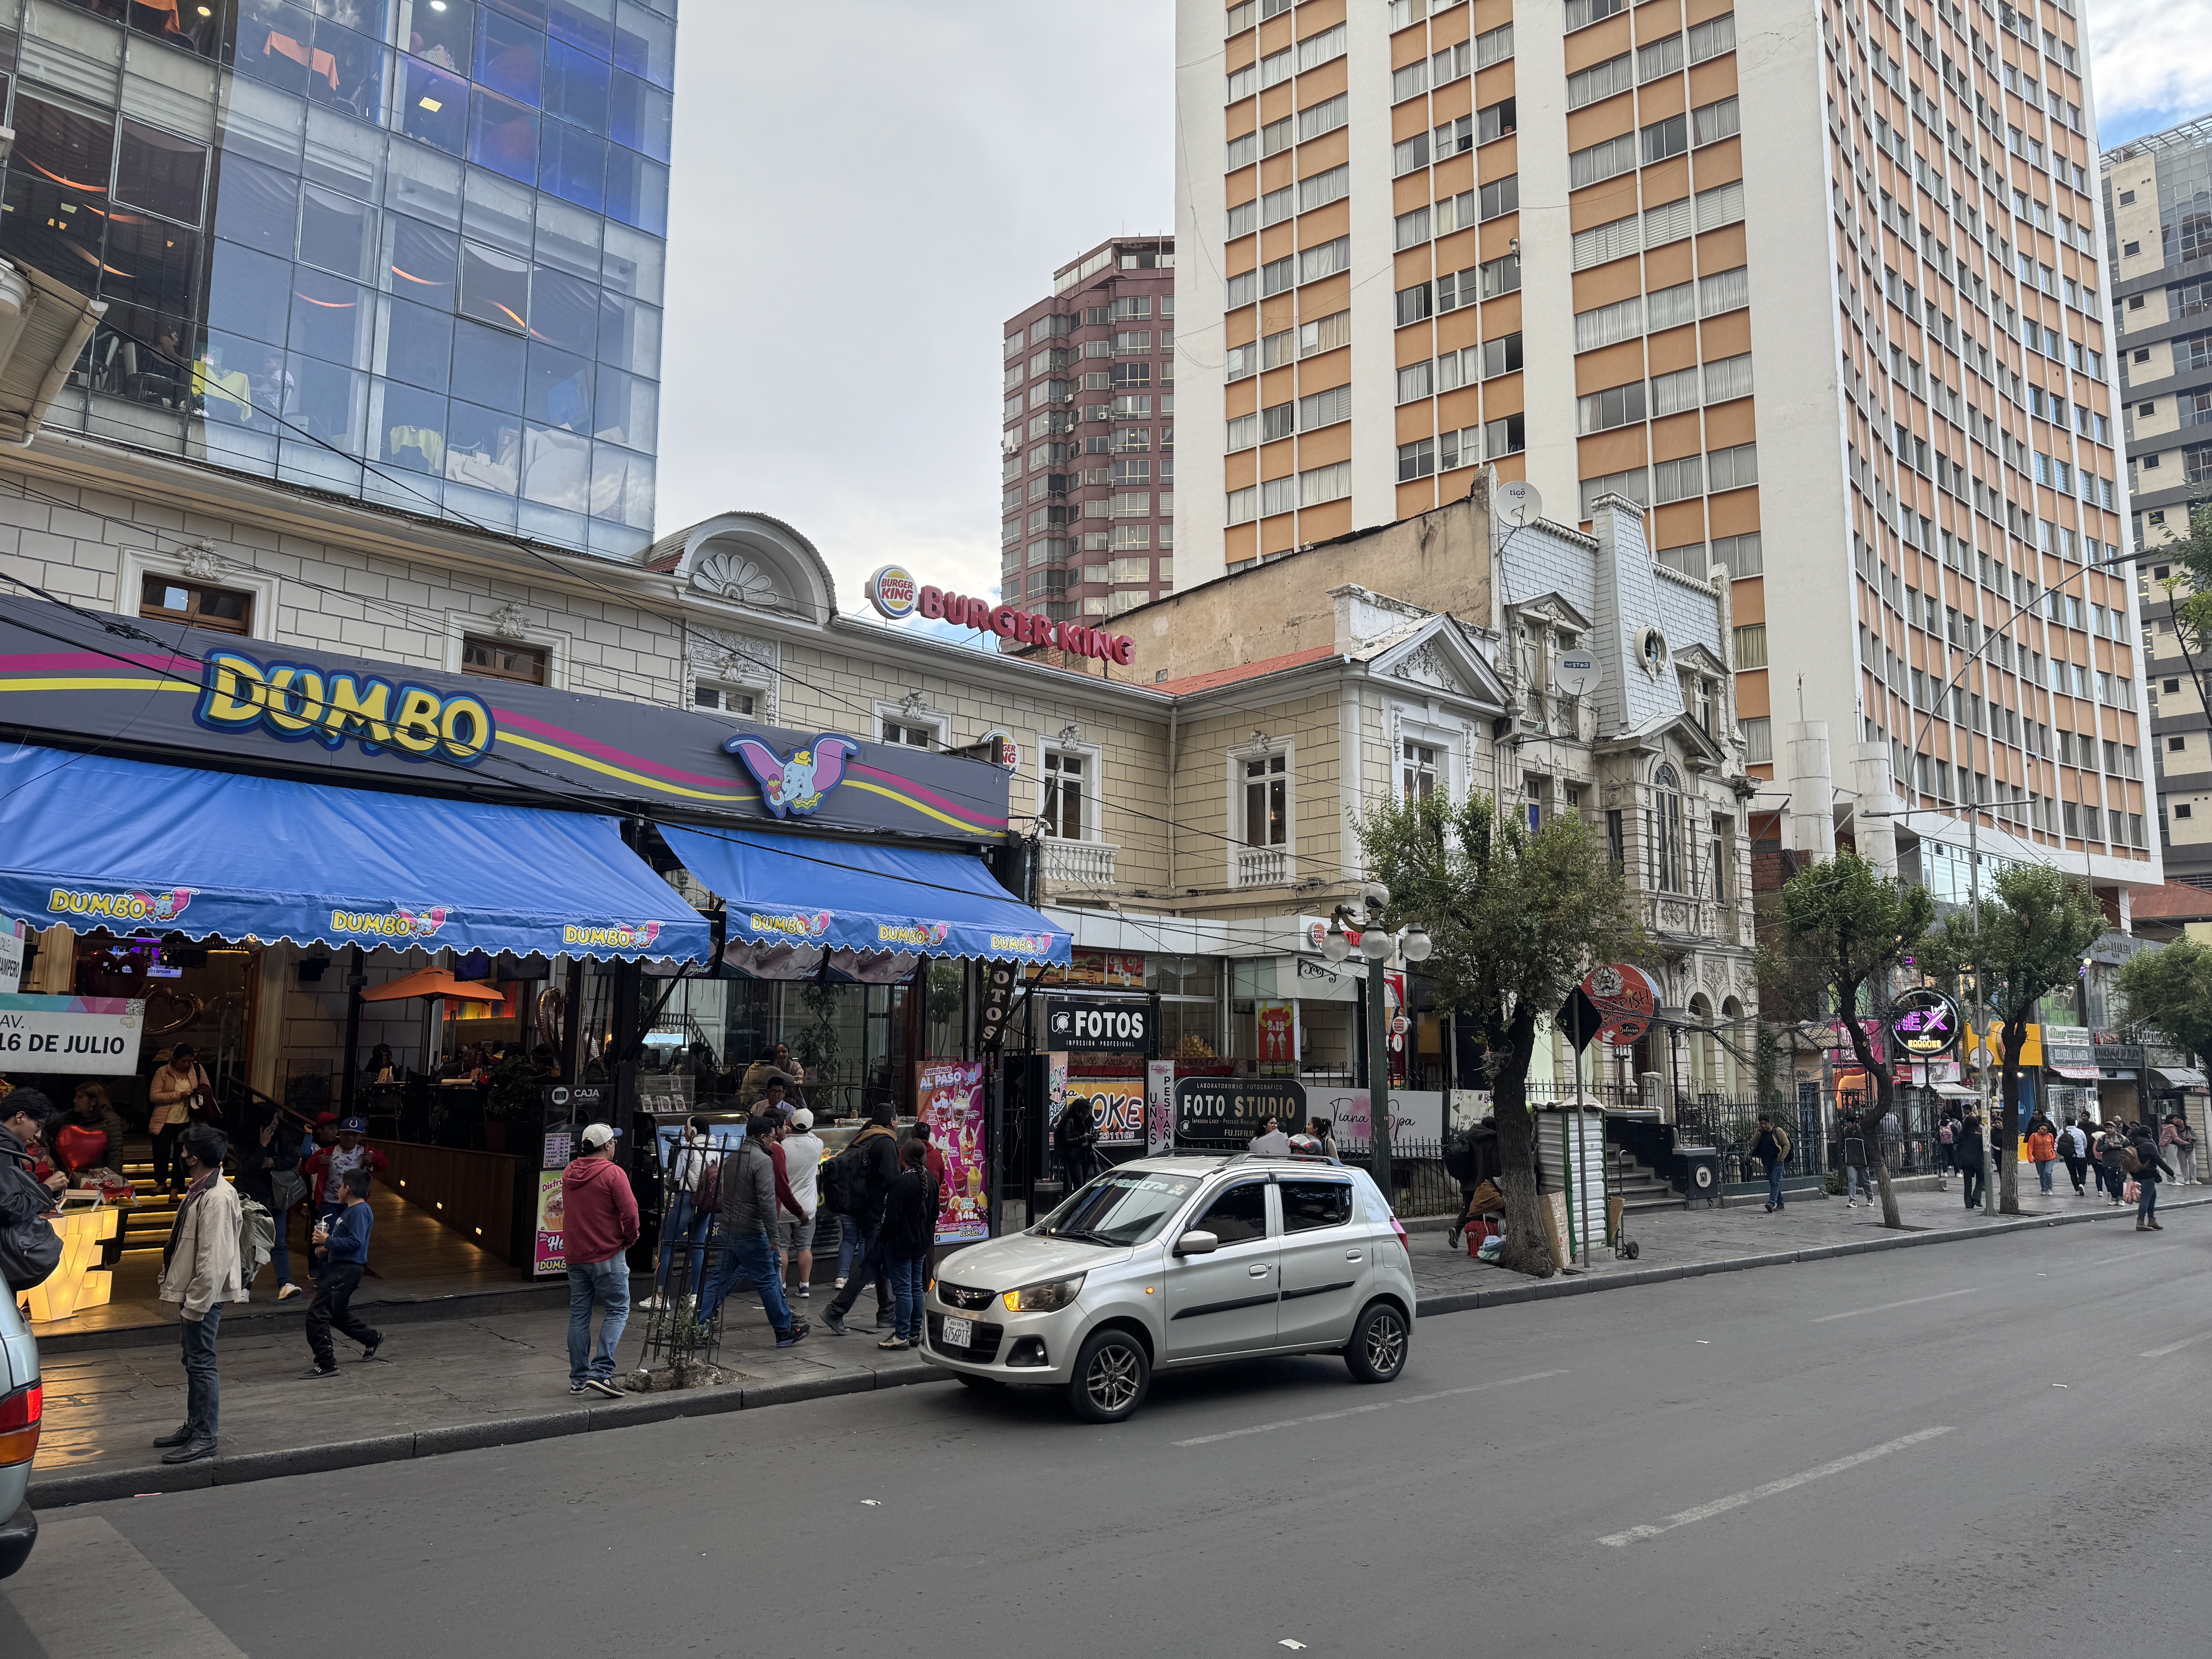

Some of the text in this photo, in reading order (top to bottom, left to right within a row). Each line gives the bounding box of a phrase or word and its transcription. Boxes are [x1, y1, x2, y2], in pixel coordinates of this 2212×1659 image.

[1510, 488, 1525, 498] tigo
[881, 579, 913, 589] BURGER
[881, 587, 914, 601] KING
[920, 584, 1135, 666] BURGER KING
[207, 656, 489, 757] DUMBO
[1003, 744, 1016, 752] GER
[1003, 752, 1017, 764] NG
[50, 890, 146, 918] DUMBO
[332, 911, 410, 935] DUMBO
[751, 915, 806, 935] DUMBO
[565, 926, 630, 947] DUMBO
[879, 925, 926, 944] DUMBO
[991, 935, 1034, 953] DUMBO
[983, 970, 1010, 1040] OTOS
[0, 1015, 24, 1029] AV.
[1075, 1010, 1144, 1039] FOTOS
[28, 1034, 59, 1052] DE
[64, 1035, 125, 1054] JULIO
[1908, 1040, 1942, 1048] KARAOKE
[926, 1066, 951, 1075] DISFRÚTALOS
[921, 1071, 962, 1090] AL PASO
[574, 1089, 599, 1097] CAJA
[1089, 1092, 1144, 1130] OKE
[1163, 1076, 1171, 1150] PESTAÑA
[1184, 1094, 1295, 1119] FOTO STUDIO
[542, 1178, 563, 1193] Disfru
[539, 1259, 567, 1271] DUMB
